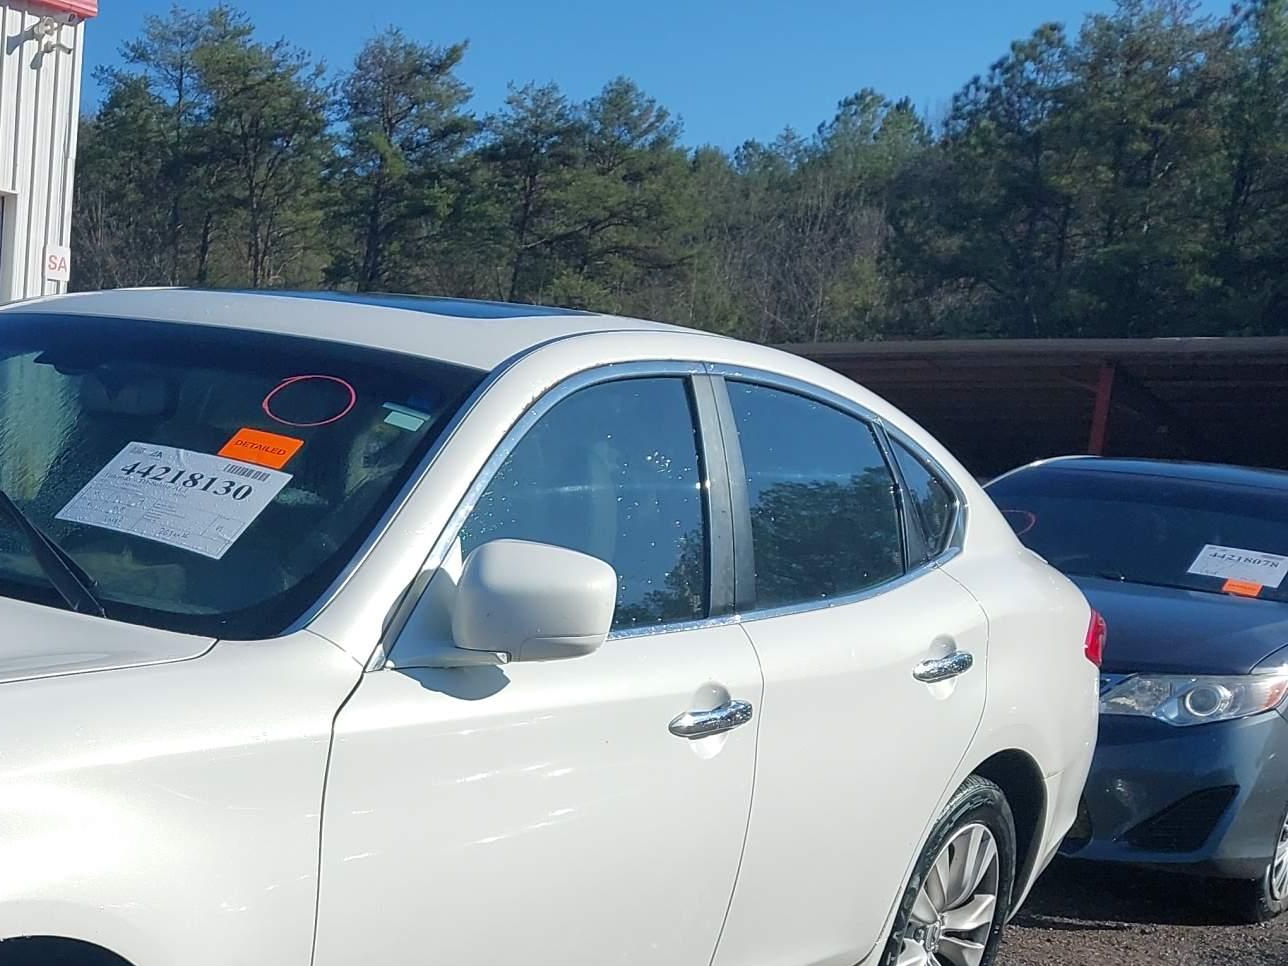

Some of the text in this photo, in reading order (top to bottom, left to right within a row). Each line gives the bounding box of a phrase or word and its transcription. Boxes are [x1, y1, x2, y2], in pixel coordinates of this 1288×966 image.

[48, 255, 67, 272] SA
[235, 439, 286, 456] DETAILED
[121, 461, 253, 501] 44218130
